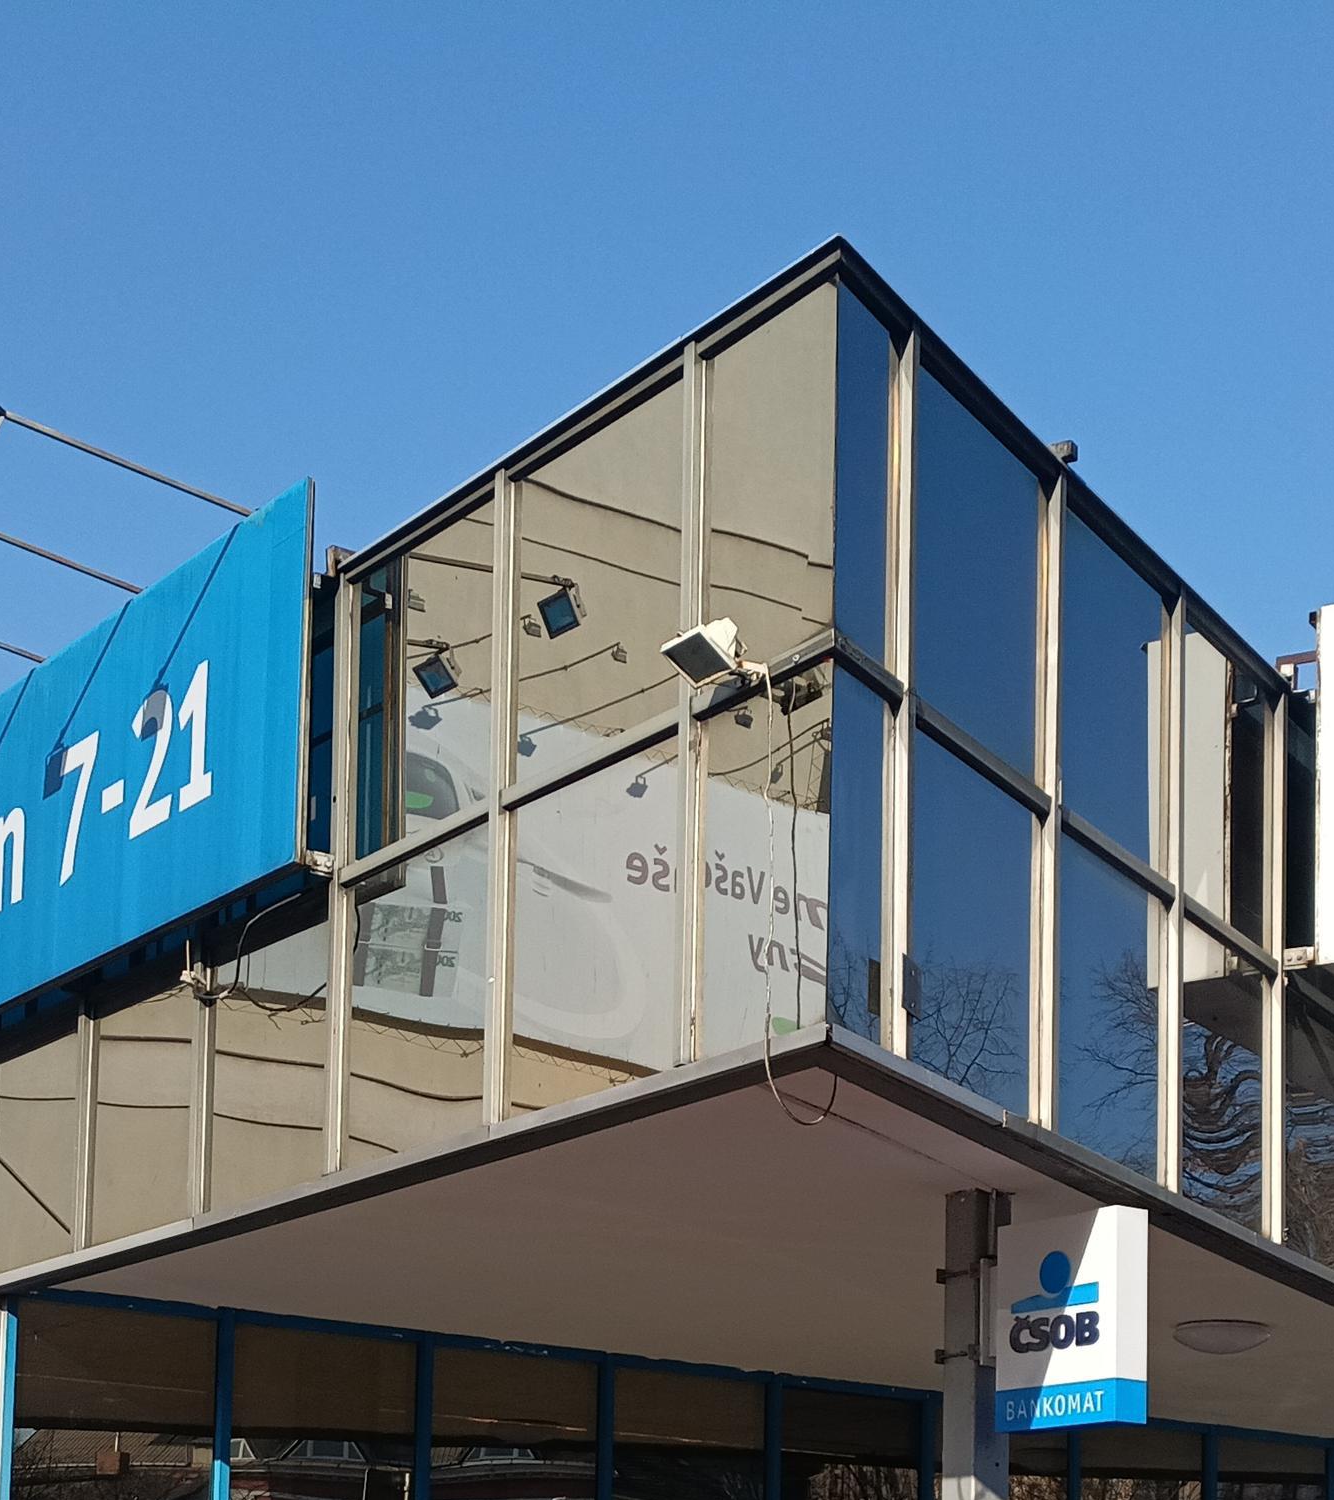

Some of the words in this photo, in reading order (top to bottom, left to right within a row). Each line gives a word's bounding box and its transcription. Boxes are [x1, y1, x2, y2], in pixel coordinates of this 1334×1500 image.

[59, 660, 213, 887] 7-21
[1009, 1311, 1100, 1353] ČSOB
[1006, 1390, 1105, 1421] BANKOMAT
